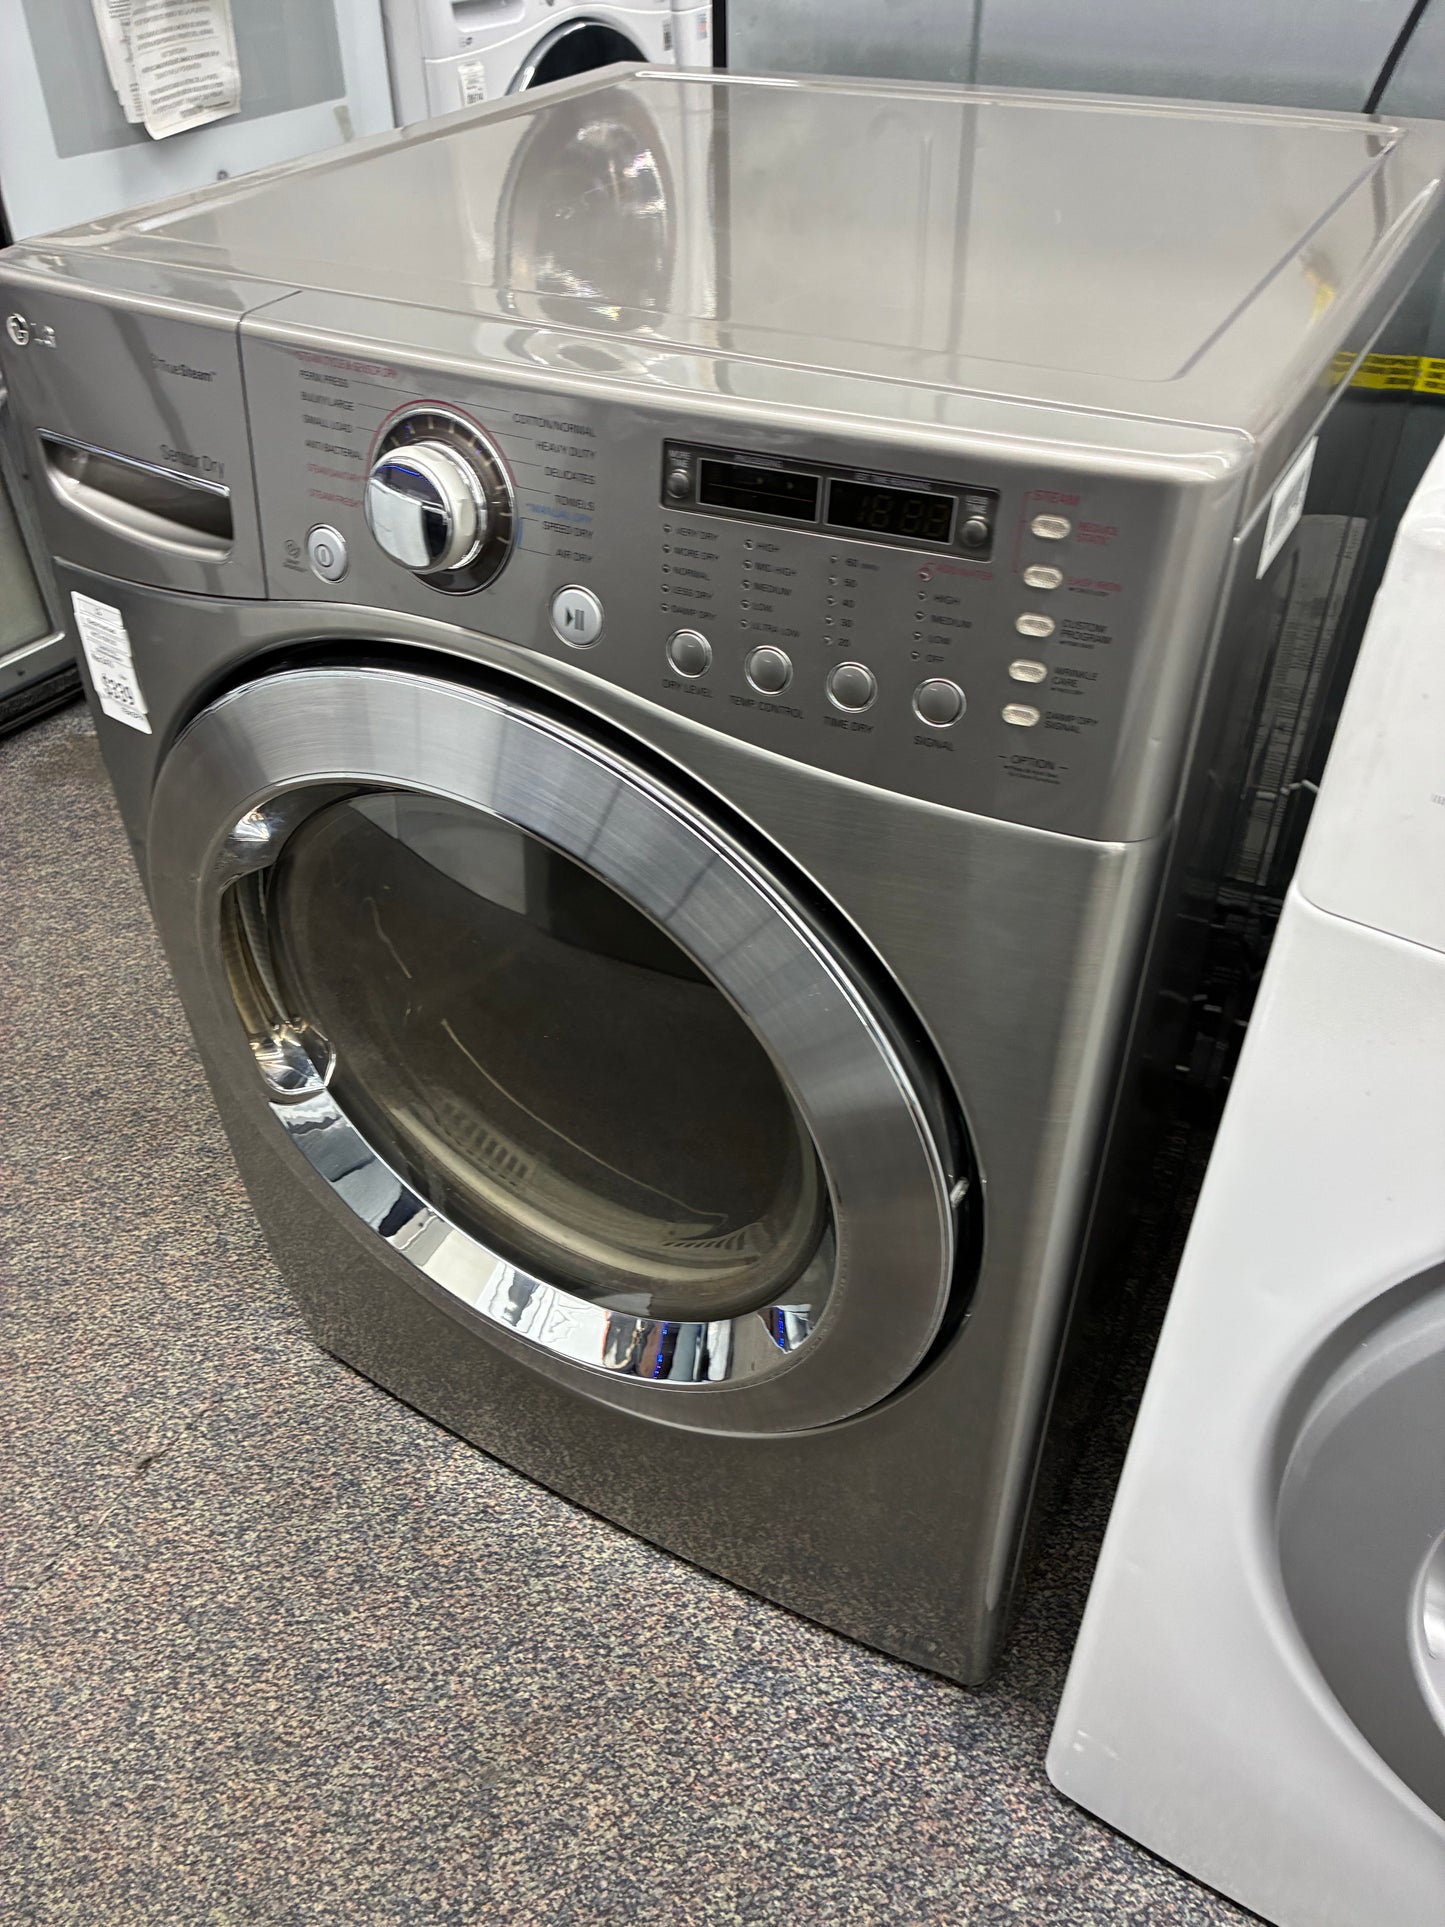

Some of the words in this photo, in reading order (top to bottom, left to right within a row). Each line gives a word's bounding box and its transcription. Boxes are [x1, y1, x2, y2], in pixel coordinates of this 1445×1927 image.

[535, 440, 567, 454] HEAVY
[569, 446, 598, 460] DUTY
[202, 455, 225, 479] Dry
[544, 466, 596, 485] DELICATES
[554, 494, 596, 511] TOWELS
[1033, 489, 1081, 507] STEAM
[543, 520, 571, 535] SPEED
[574, 527, 594, 540] DRY
[933, 594, 961, 605] HIGH
[930, 614, 973, 629] MEDIUM
[1062, 618, 1107, 633] CUSTOM
[928, 634, 953, 646] LOW
[1060, 628, 1113, 645] PROGRAM
[925, 654, 945, 664] OFF
[1052, 676, 1079, 689] CARE
[1053, 666, 1099, 682] WRINKLE
[662, 678, 683, 693] DRY
[684, 682, 713, 699] LEVEL
[729, 695, 755, 708] TEMP
[757, 701, 804, 720] CONTROL
[824, 716, 849, 731] TIME
[851, 722, 875, 735] DRY
[1043, 720, 1081, 735] SIGNAL
[913, 735, 954, 752] SIGNAL
[1010, 754, 1056, 771] OPTION
